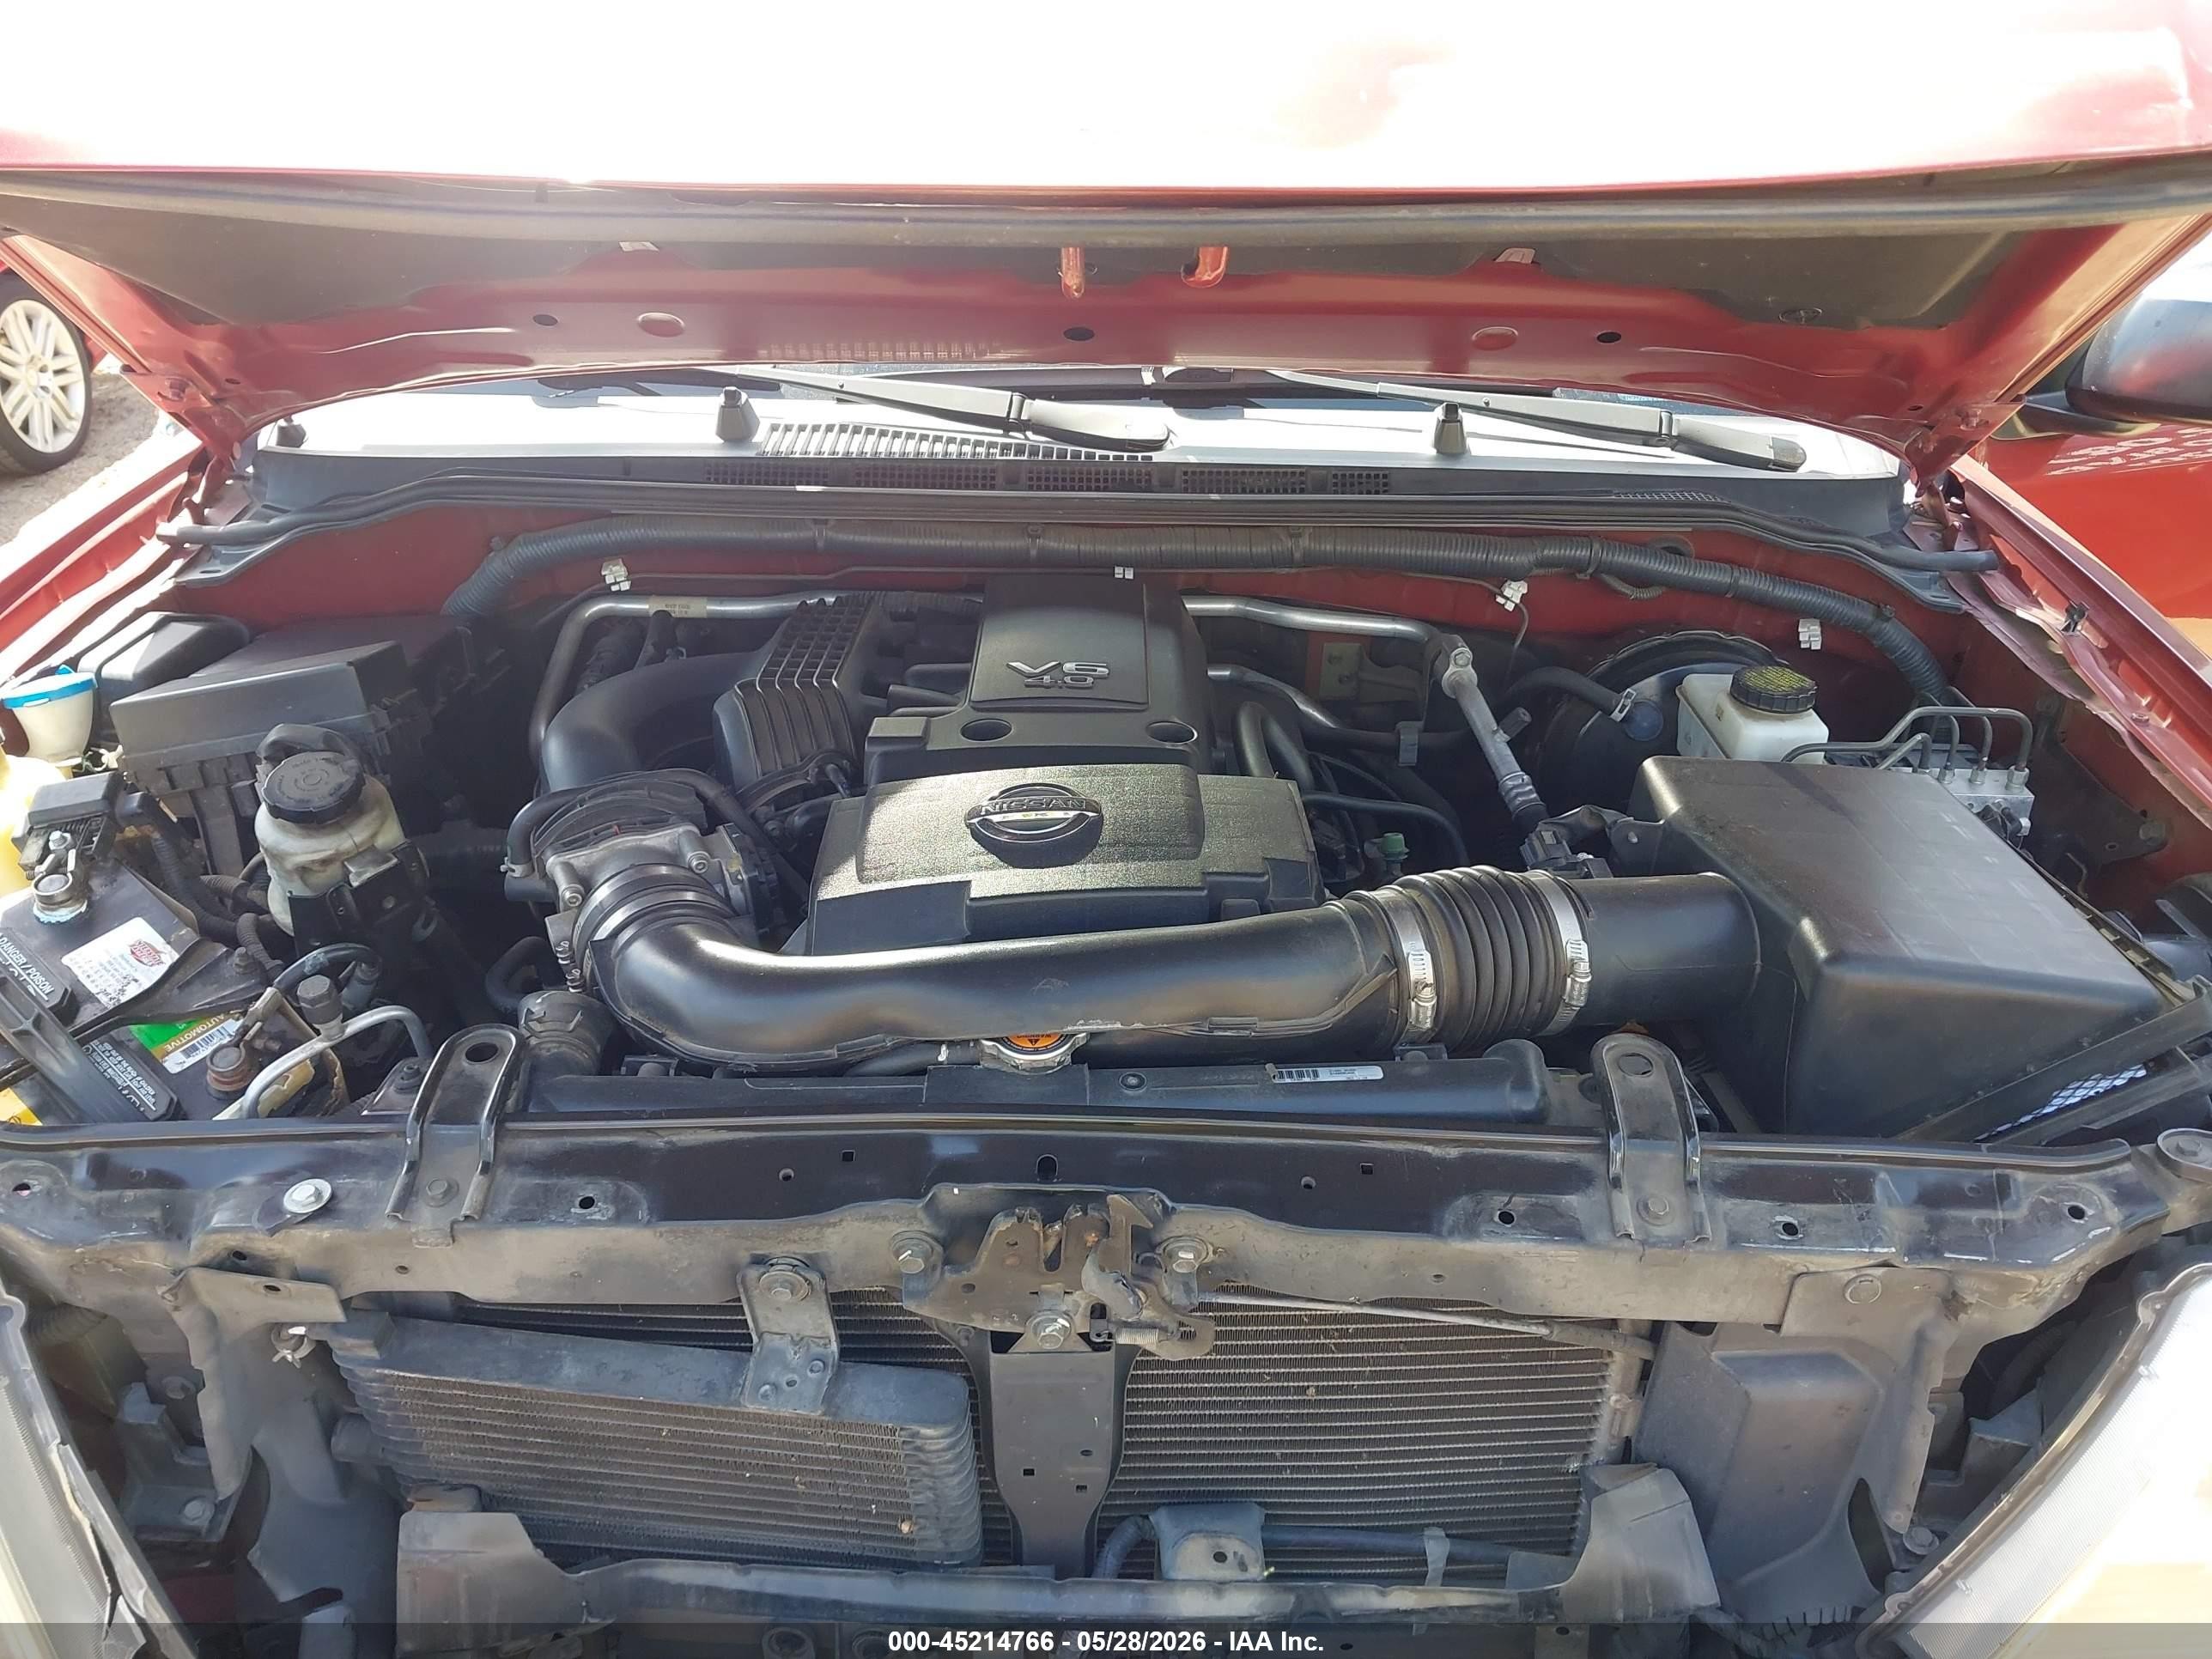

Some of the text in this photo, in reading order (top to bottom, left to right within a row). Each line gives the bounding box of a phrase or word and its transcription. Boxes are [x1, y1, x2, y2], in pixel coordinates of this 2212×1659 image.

[1006, 661, 1109, 678] V6
[1024, 675, 1094, 689] 4.0
[981, 798, 1086, 815] NISSAN
[164, 1014, 225, 1053] AUTOMOTIVE
